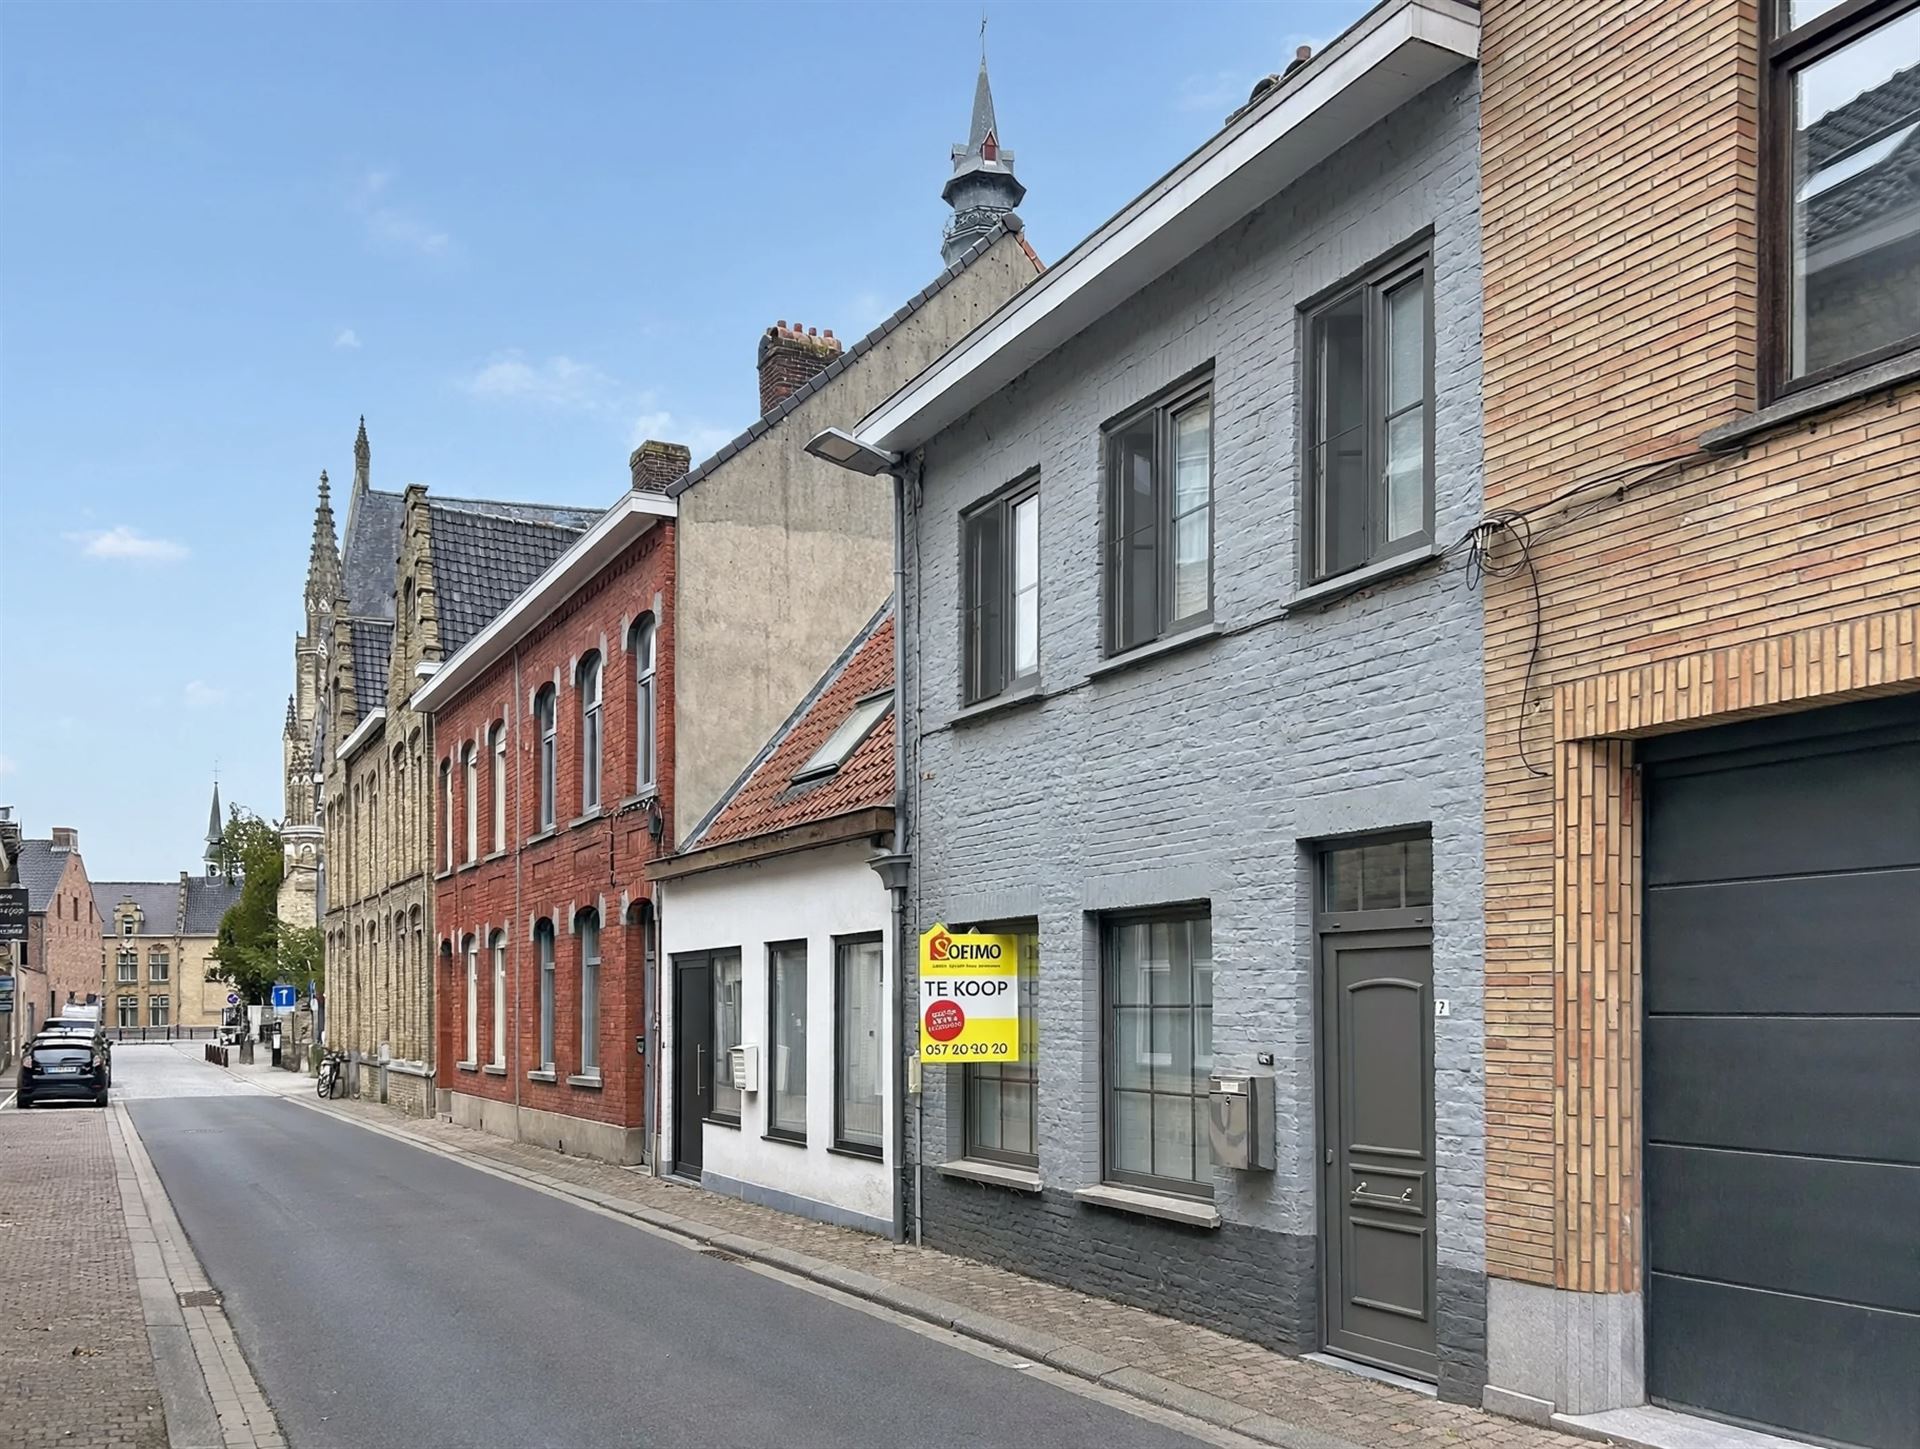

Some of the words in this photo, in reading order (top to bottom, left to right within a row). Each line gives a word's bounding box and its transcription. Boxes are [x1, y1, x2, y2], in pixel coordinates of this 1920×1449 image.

[924, 981, 948, 997] TE
[954, 980, 1008, 996] KOOP
[925, 1044, 949, 1055] 057
[952, 1043, 969, 1055] 20
[991, 1042, 1008, 1054] 20
